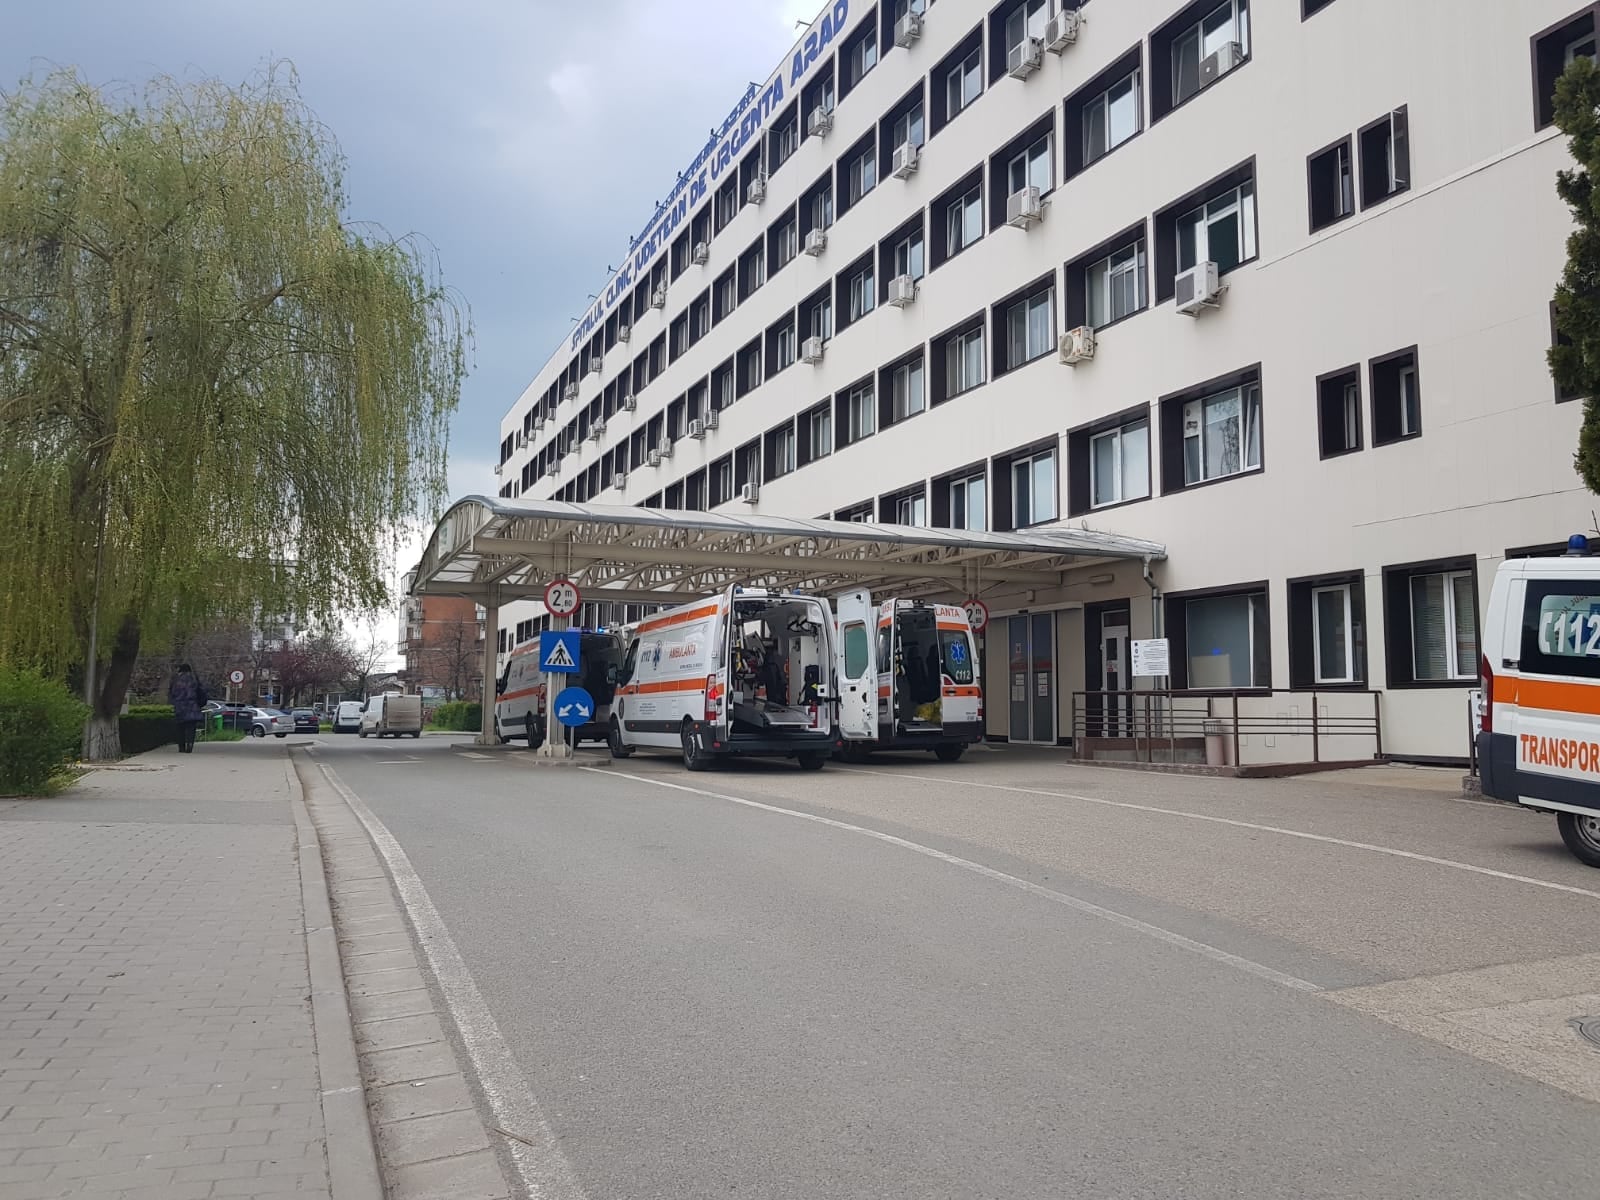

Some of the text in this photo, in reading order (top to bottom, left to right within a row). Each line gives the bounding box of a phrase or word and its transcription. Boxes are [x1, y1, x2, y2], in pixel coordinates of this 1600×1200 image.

[571, 300, 604, 353] SPITALUL
[606, 261, 632, 308] CLINIC
[634, 193, 687, 283] JUDETEAN
[690, 167, 707, 209] DE
[711, 74, 784, 181] URGENTA
[791, 0, 849, 88] ARAD
[553, 589, 561, 606] 2
[1554, 612, 1600, 655] 112
[235, 672, 240, 680] 5
